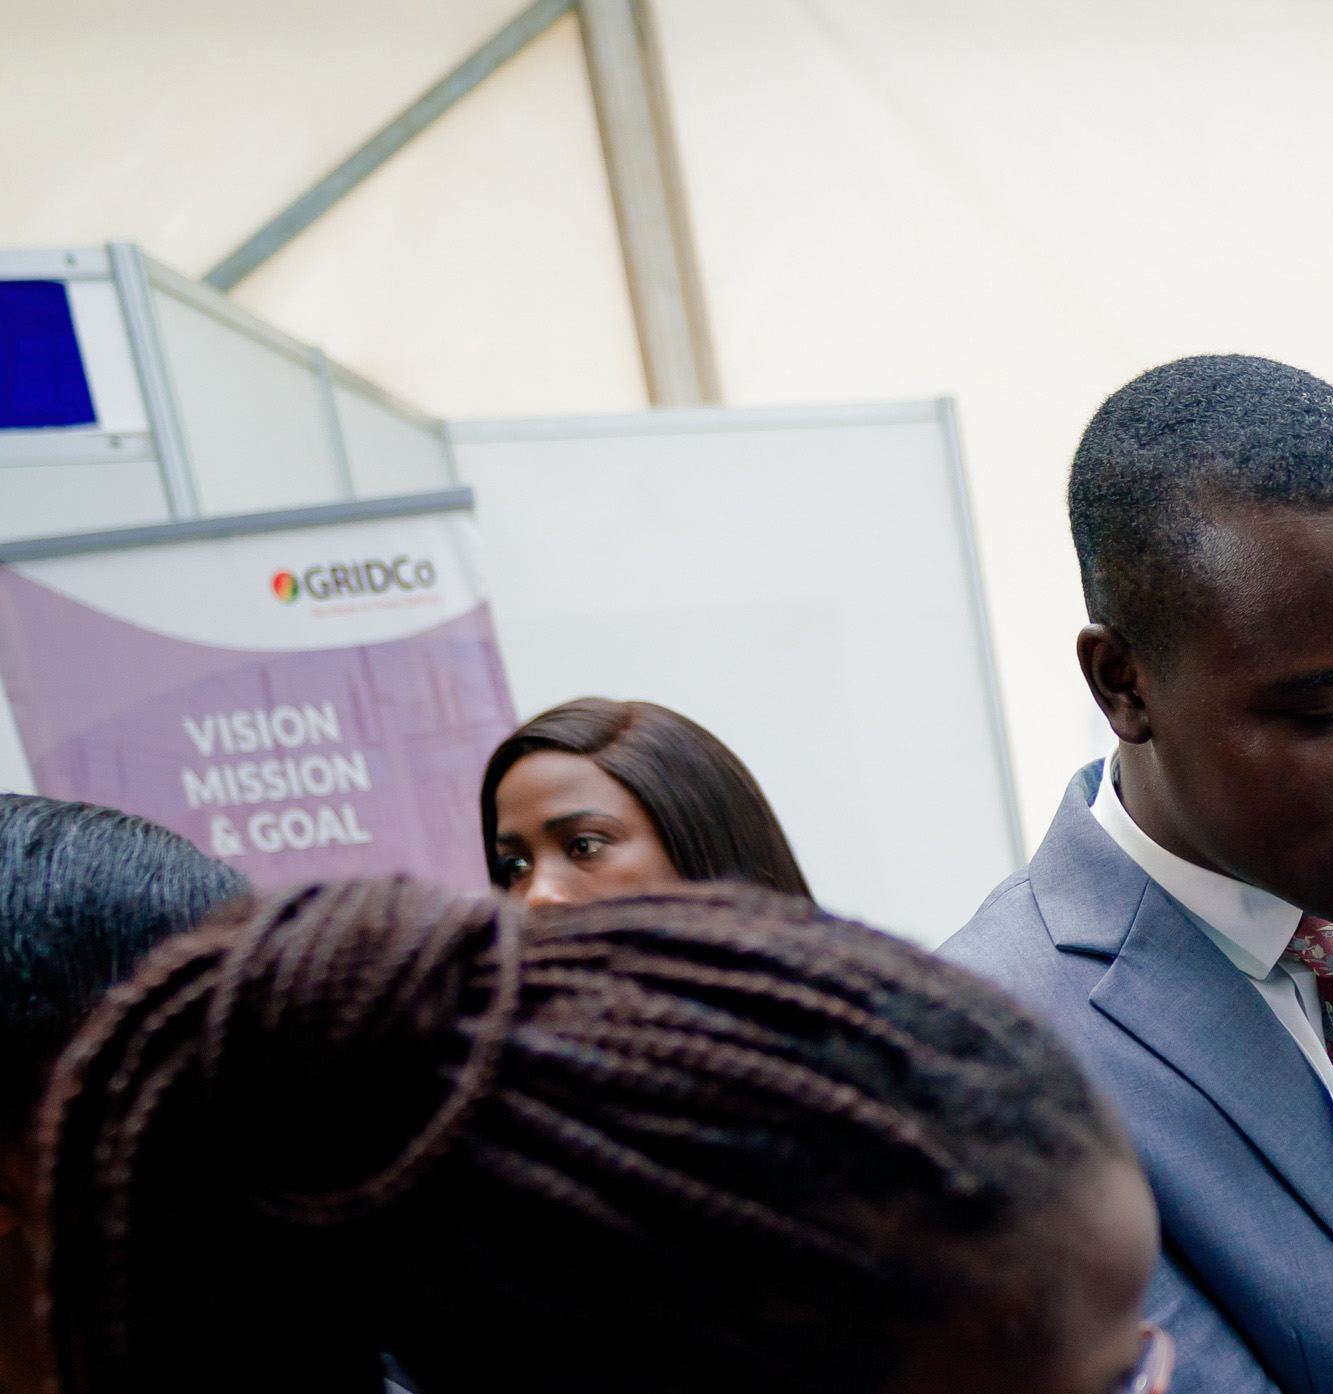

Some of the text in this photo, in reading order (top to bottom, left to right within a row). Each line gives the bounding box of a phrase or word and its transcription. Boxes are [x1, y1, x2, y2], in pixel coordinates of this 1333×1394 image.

[301, 554, 437, 602] GRIDCo
[182, 699, 343, 757] VISION
[180, 751, 373, 809] MISSION
[209, 801, 373, 859] & GOAL
